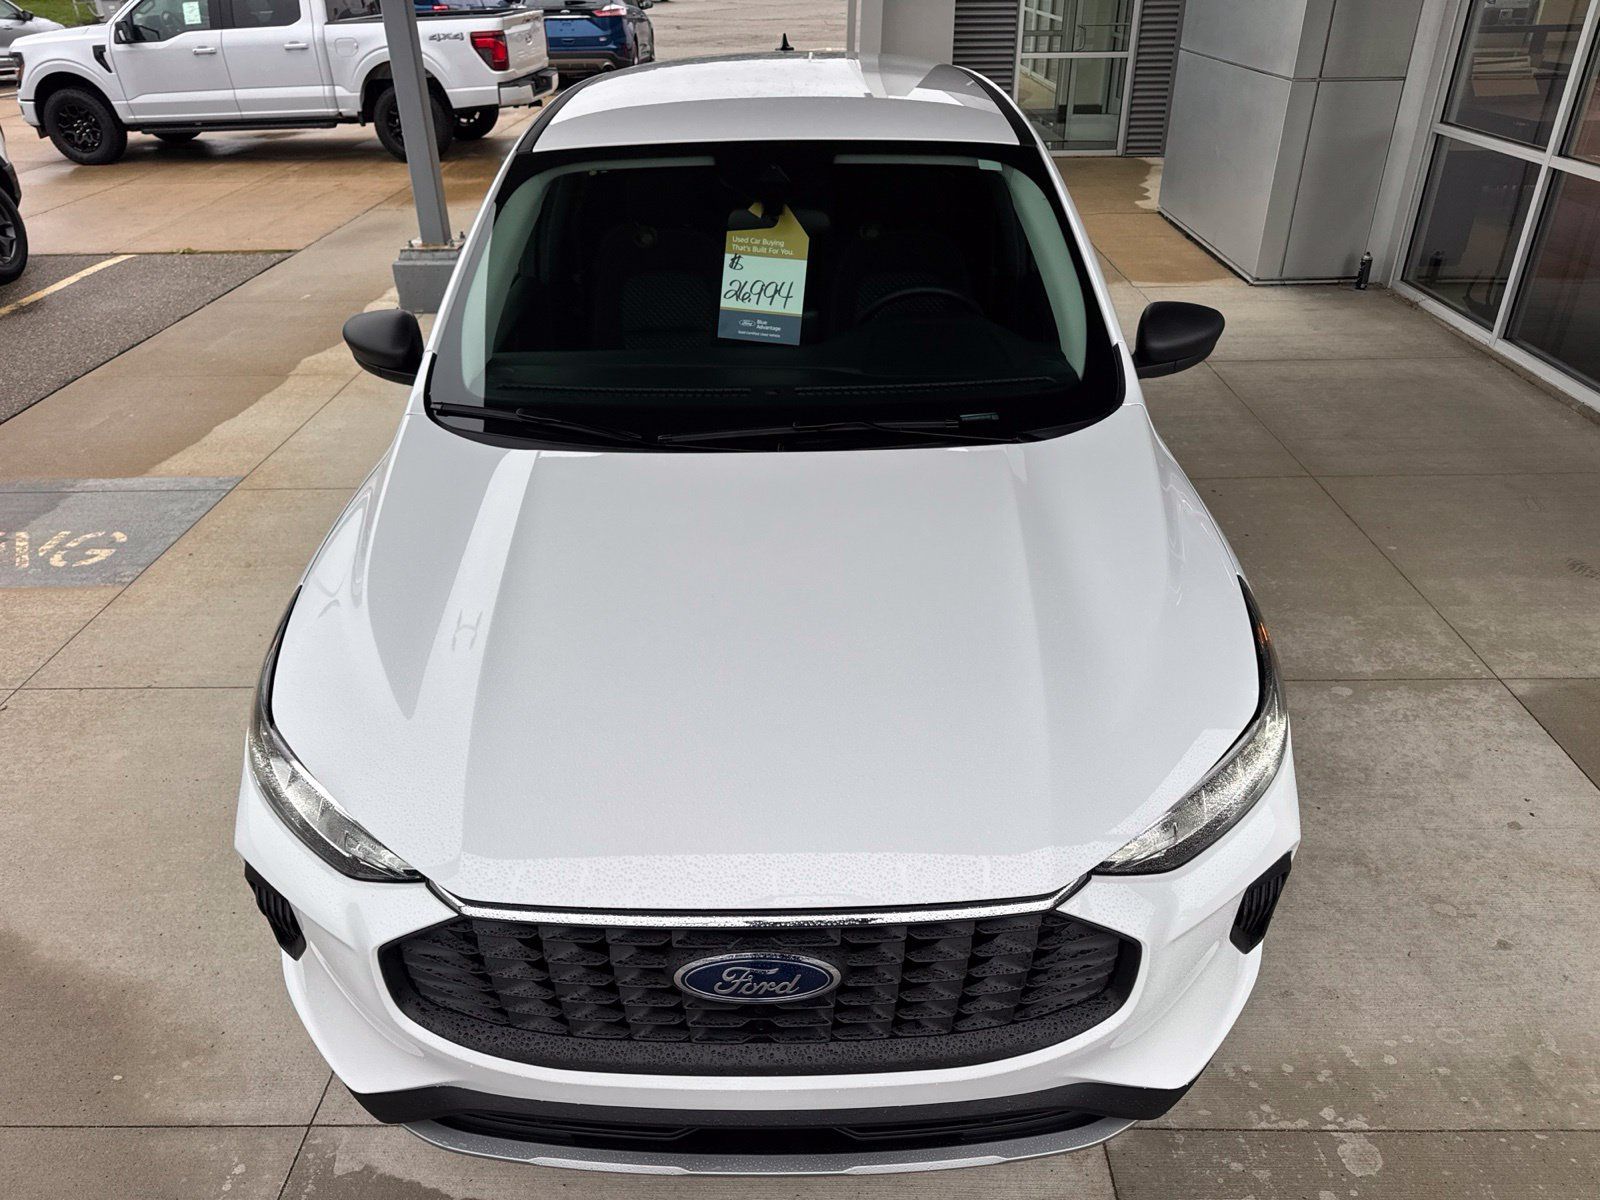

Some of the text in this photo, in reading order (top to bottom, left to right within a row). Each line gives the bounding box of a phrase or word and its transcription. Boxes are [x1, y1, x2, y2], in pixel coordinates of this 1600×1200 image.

[762, 238, 785, 248] Buying
[732, 243, 751, 252] That's
[752, 245, 767, 253] Built
[768, 247, 780, 255] For
[755, 324, 782, 332] Advantage
[713, 966, 801, 995] Ford
